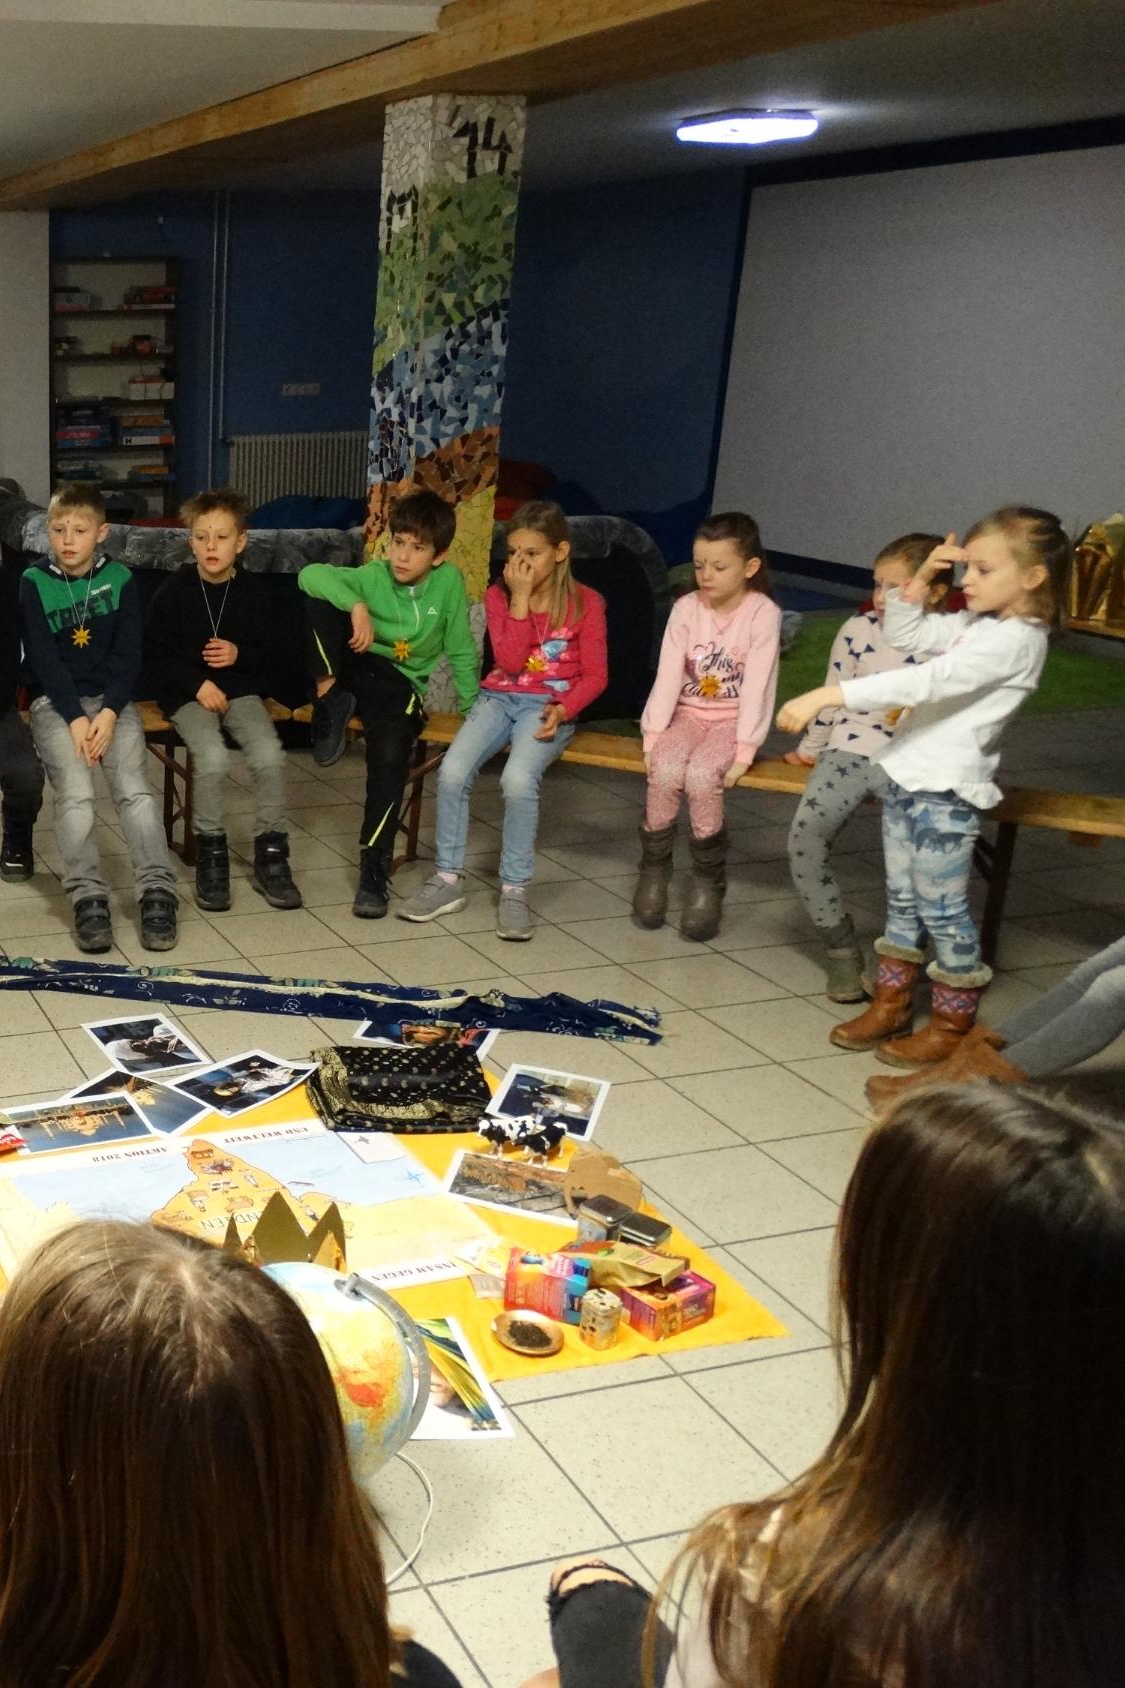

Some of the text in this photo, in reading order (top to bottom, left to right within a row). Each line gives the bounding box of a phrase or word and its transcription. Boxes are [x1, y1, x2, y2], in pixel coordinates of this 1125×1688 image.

[223, 1129, 283, 1144] WELTWEIT
[92, 1146, 168, 1163] AKTION 2018
